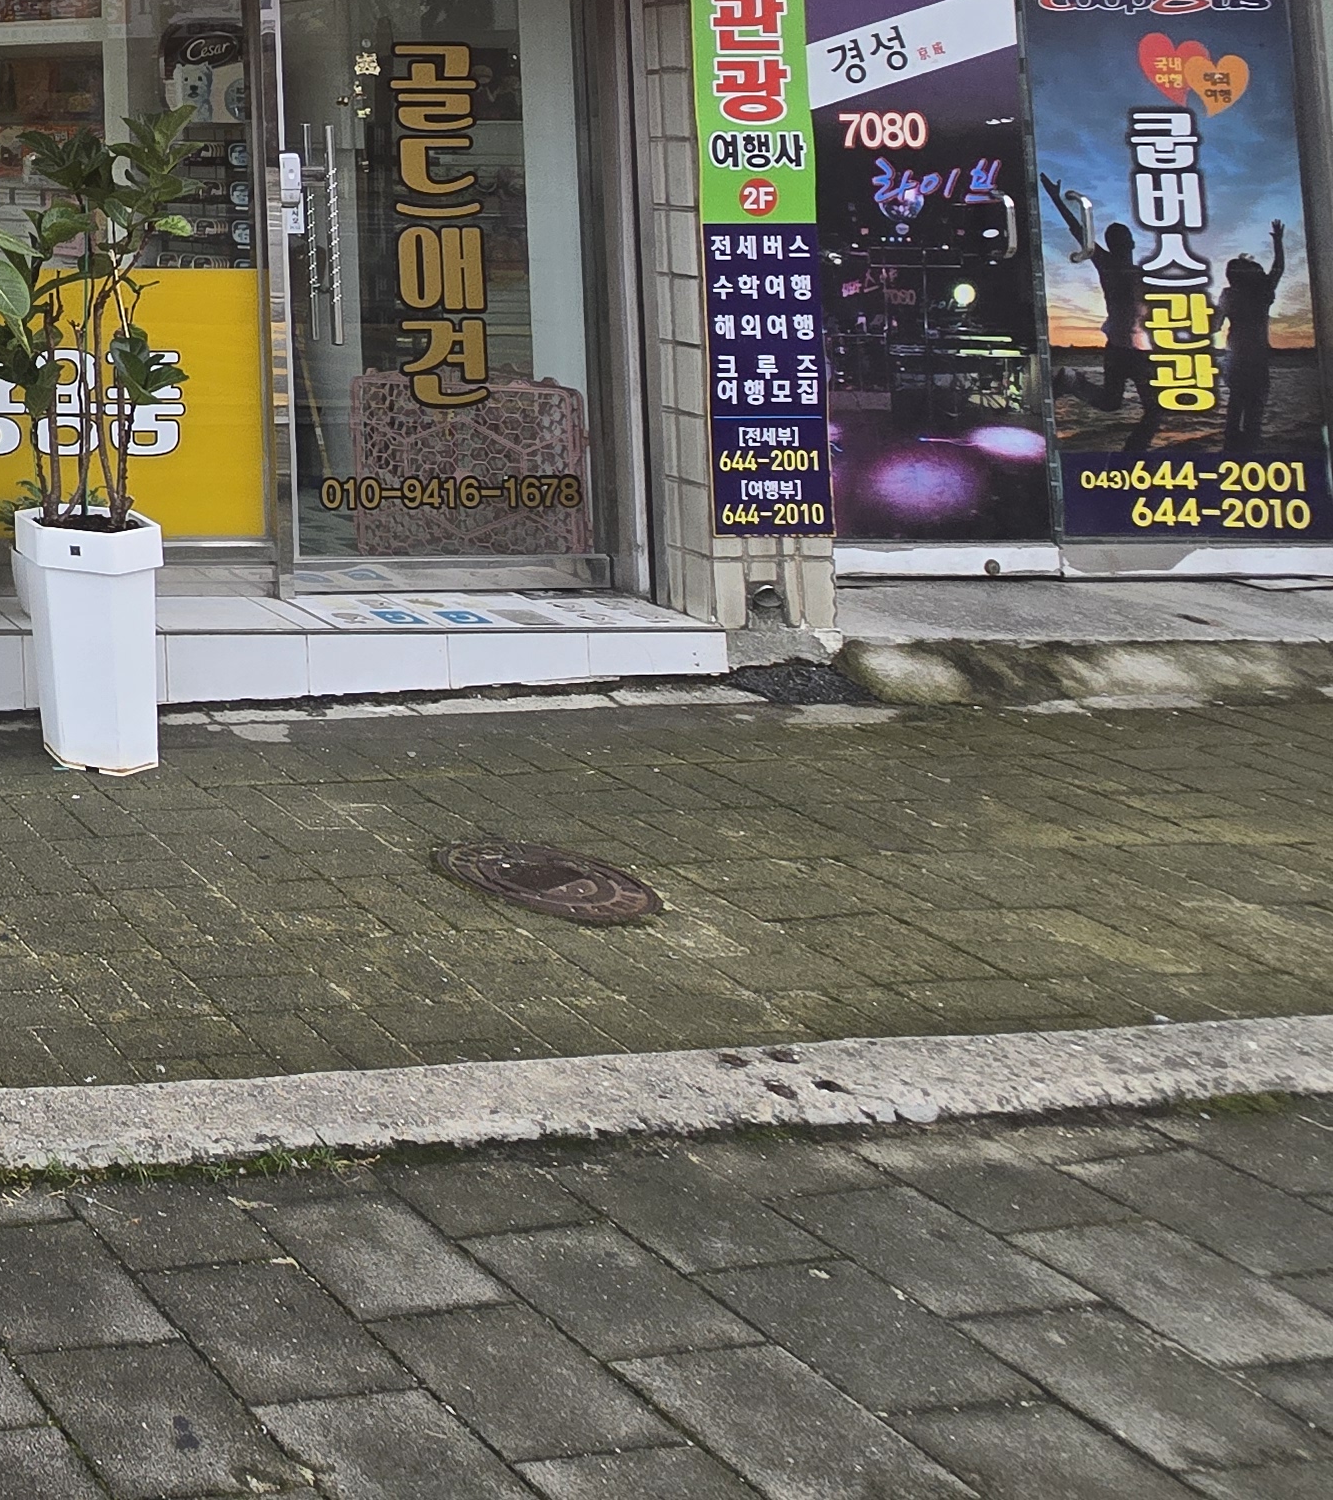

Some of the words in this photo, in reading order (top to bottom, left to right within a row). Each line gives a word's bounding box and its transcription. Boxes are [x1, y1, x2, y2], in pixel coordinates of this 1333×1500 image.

[186, 39, 230, 61] Cesar
[826, 25, 908, 84] 경성
[1154, 57, 1182, 71] 국내
[1155, 74, 1182, 88] 여행
[1205, 89, 1232, 103] 여행
[838, 111, 928, 149] 7080
[709, 131, 807, 170] 여행사
[742, 187, 775, 209] 2F
[390, 42, 490, 406] 골드애견
[719, 450, 820, 472] 644-2001
[321, 476, 582, 511] 010-9416-1678
[721, 503, 825, 525] 644-2010
[1132, 497, 1311, 529] 644-2010
